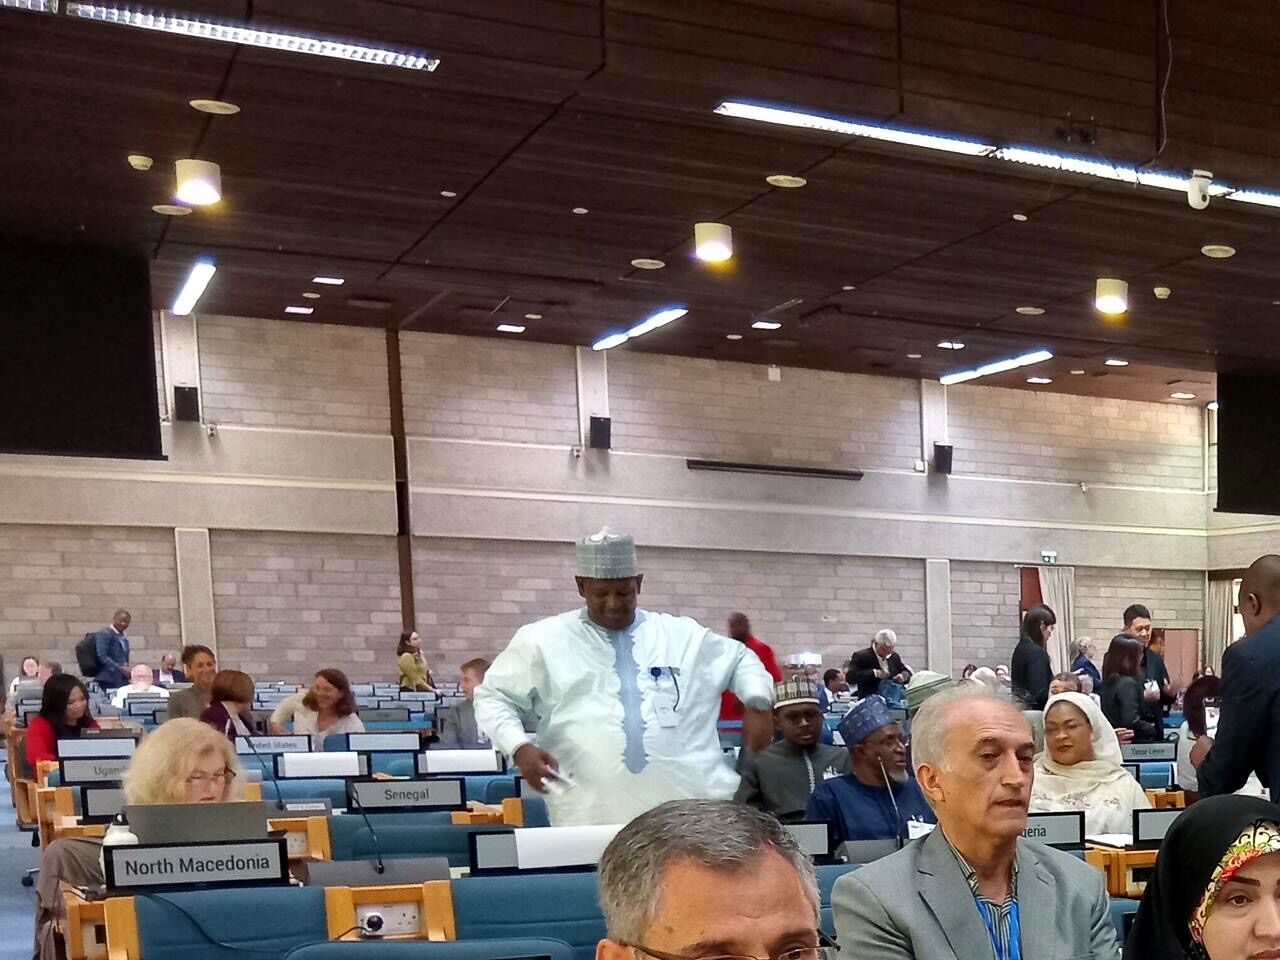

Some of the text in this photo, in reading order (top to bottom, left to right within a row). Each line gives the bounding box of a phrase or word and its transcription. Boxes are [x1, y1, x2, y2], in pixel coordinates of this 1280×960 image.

[94, 766, 126, 777] Ugan
[384, 788, 429, 802] Senegal
[1020, 824, 1047, 838] geria
[125, 853, 271, 876] North Macedonia
